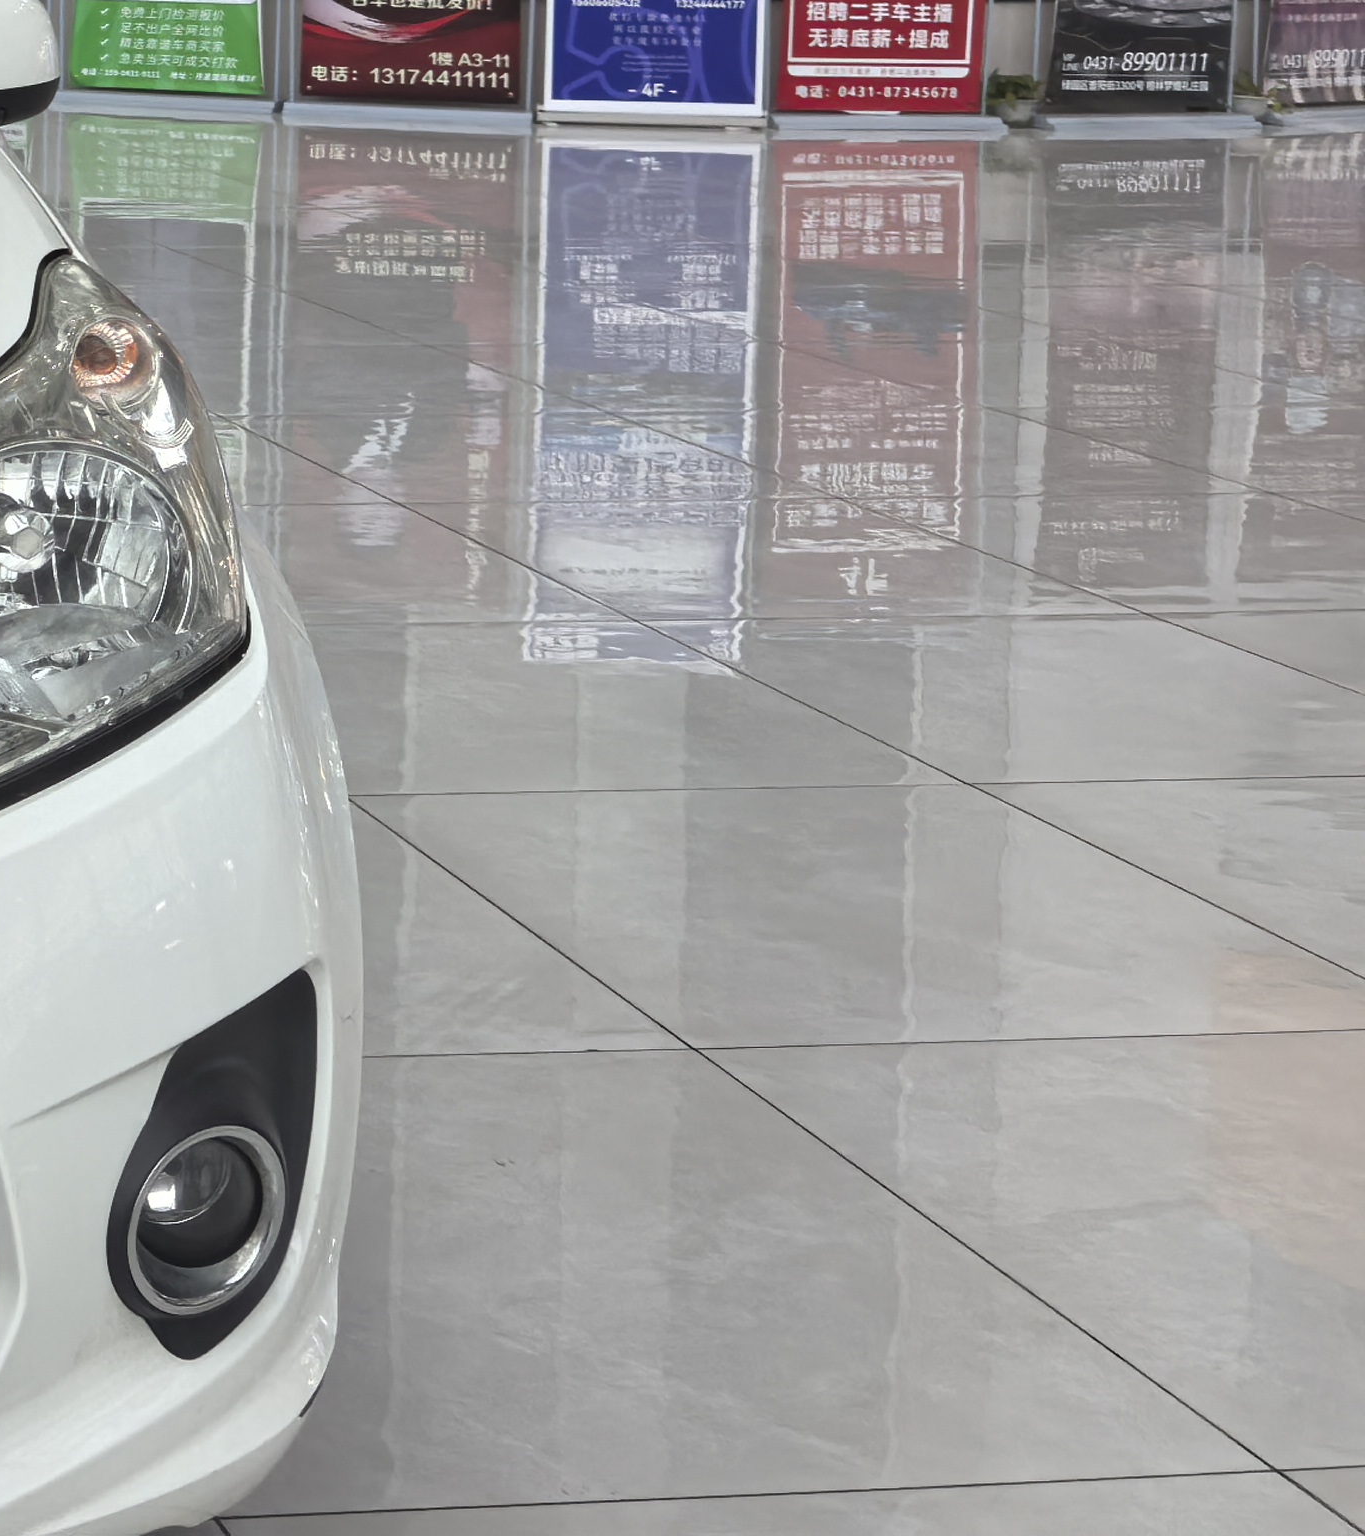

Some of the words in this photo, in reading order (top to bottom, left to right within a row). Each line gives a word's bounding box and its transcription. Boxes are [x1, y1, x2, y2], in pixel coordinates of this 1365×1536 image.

[806, 1, 953, 23] 招聘二手车主播
[808, 28, 950, 49] 无责底薪+提成
[458, 52, 511, 69] A3-11
[1082, 52, 1209, 72] 0431-89901111
